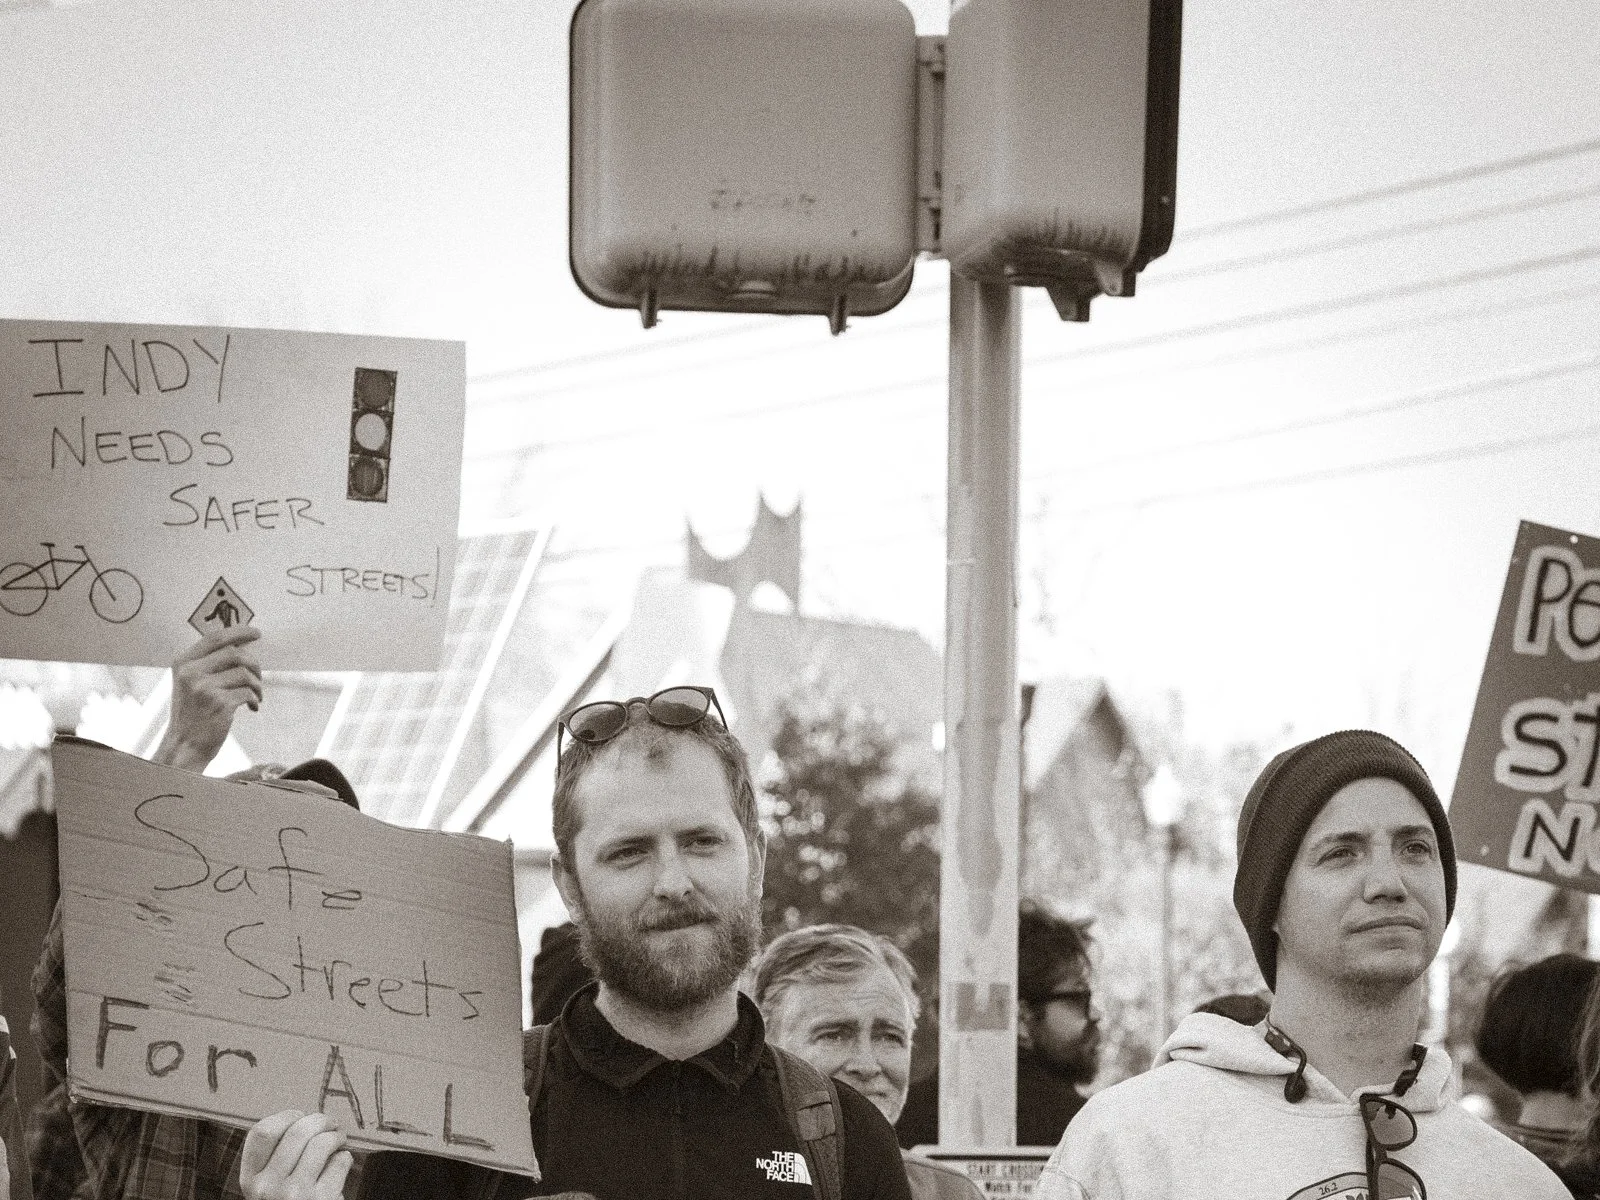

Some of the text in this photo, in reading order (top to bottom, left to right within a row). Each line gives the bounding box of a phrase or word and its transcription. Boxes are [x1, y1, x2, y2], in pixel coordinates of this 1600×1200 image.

[28, 334, 231, 404] INDY
[51, 415, 235, 470] NEEDS
[162, 483, 326, 533] SAFER
[134, 793, 363, 911] Safe
[223, 921, 484, 1020] Streets
[95, 995, 497, 1152] For ALL
[756, 1158, 794, 1172] NORTH
[766, 1169, 794, 1182] FACE
[772, 1150, 794, 1162] THE
[1318, 1182, 1339, 1195] 26.2
